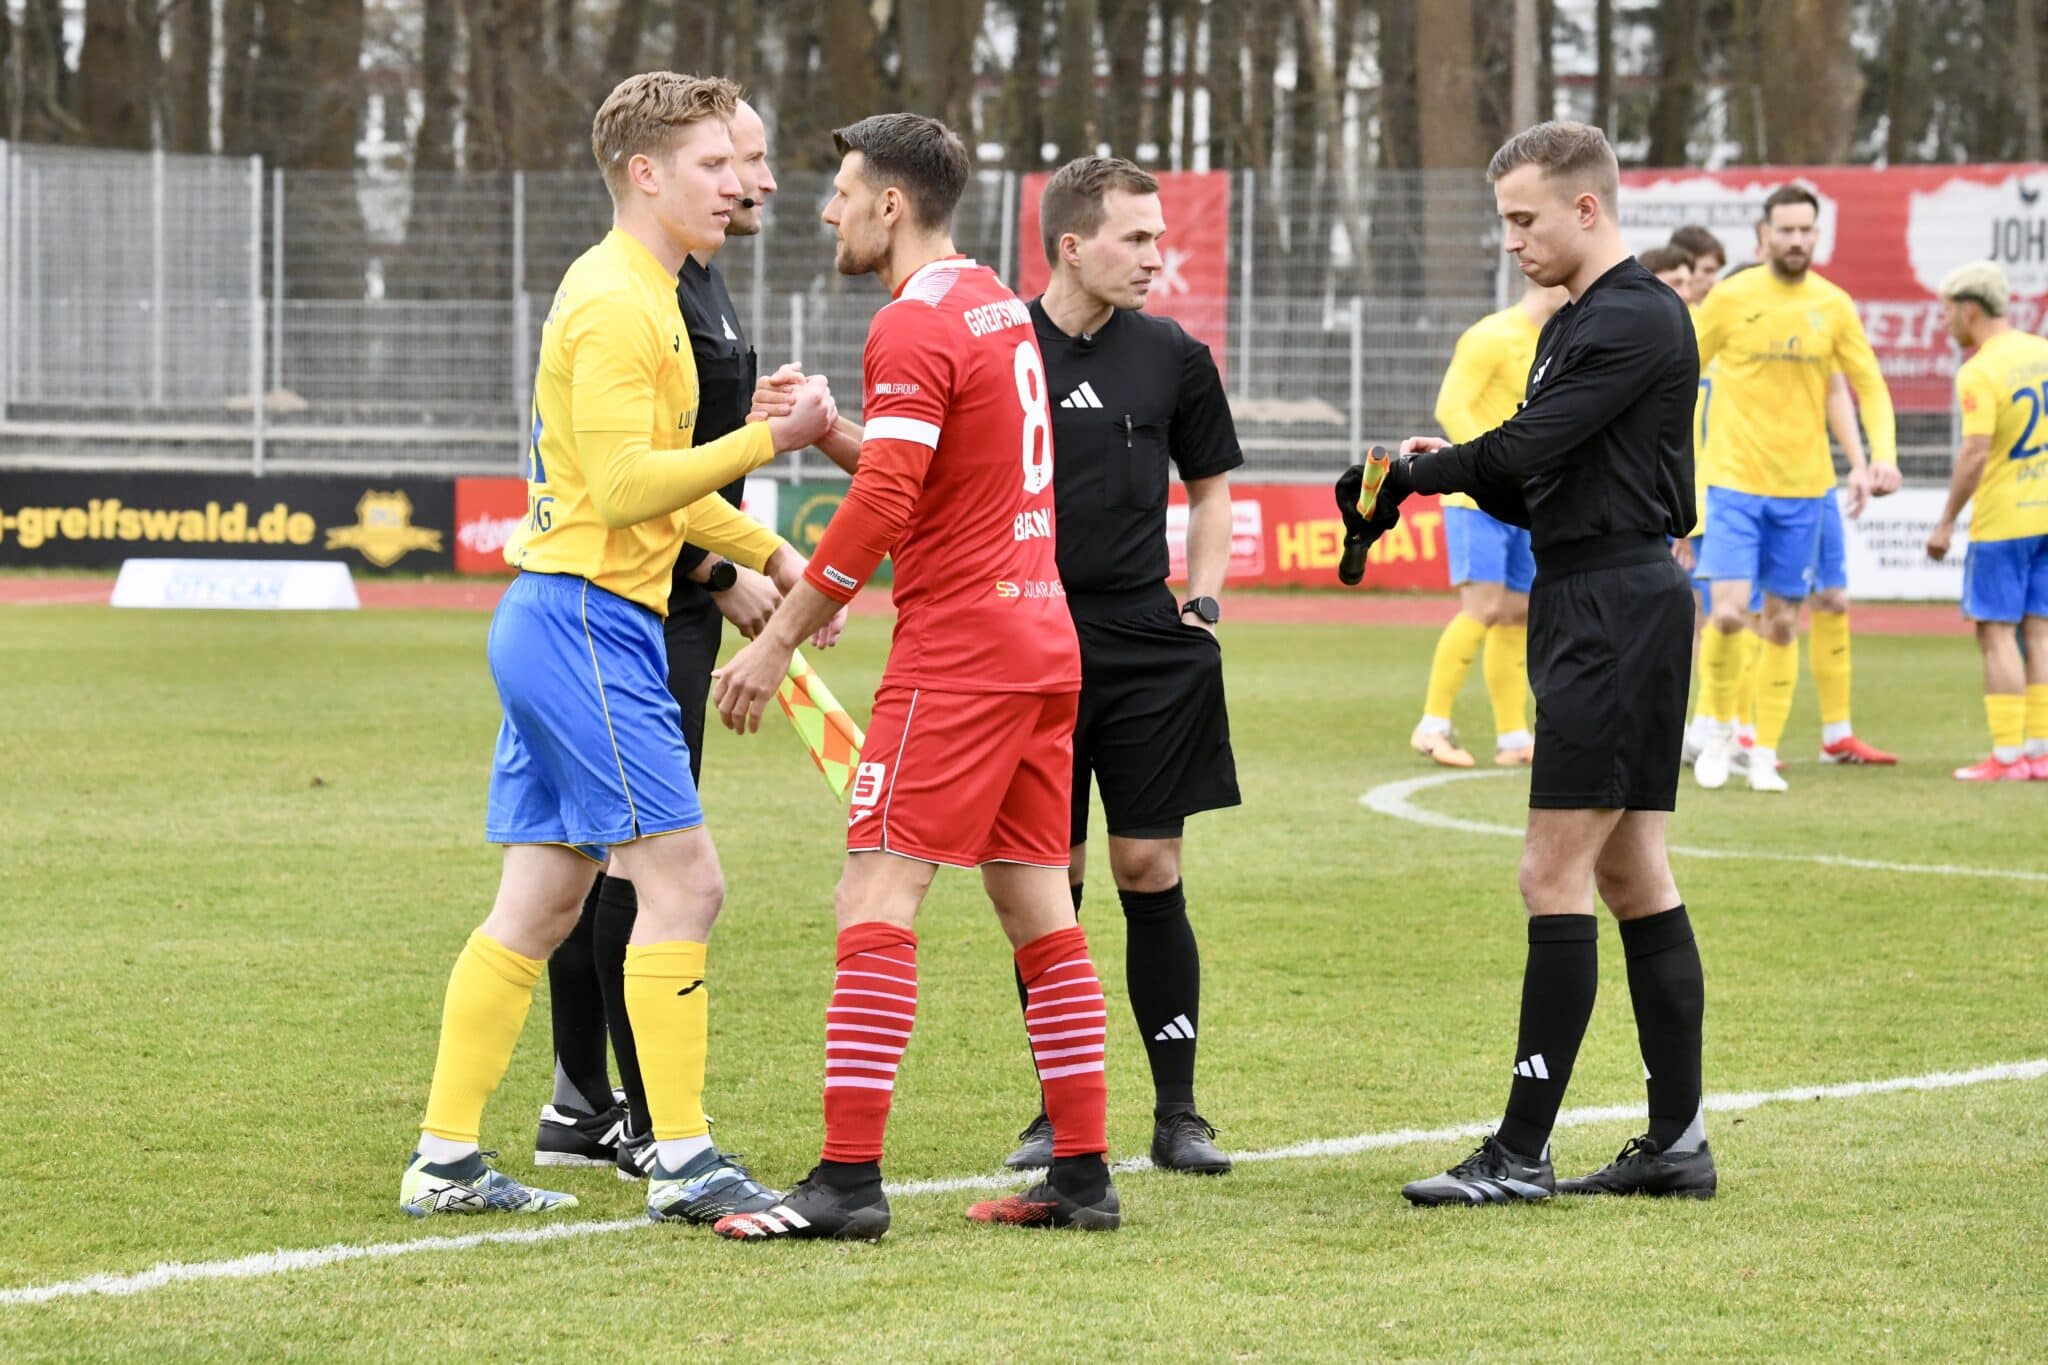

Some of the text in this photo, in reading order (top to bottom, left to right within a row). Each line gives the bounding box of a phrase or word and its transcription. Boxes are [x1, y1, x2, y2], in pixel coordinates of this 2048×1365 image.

[1014, 340, 1054, 494] 8
[0, 497, 317, 549] -greifswald.de
[825, 567, 856, 588] uhlsport
